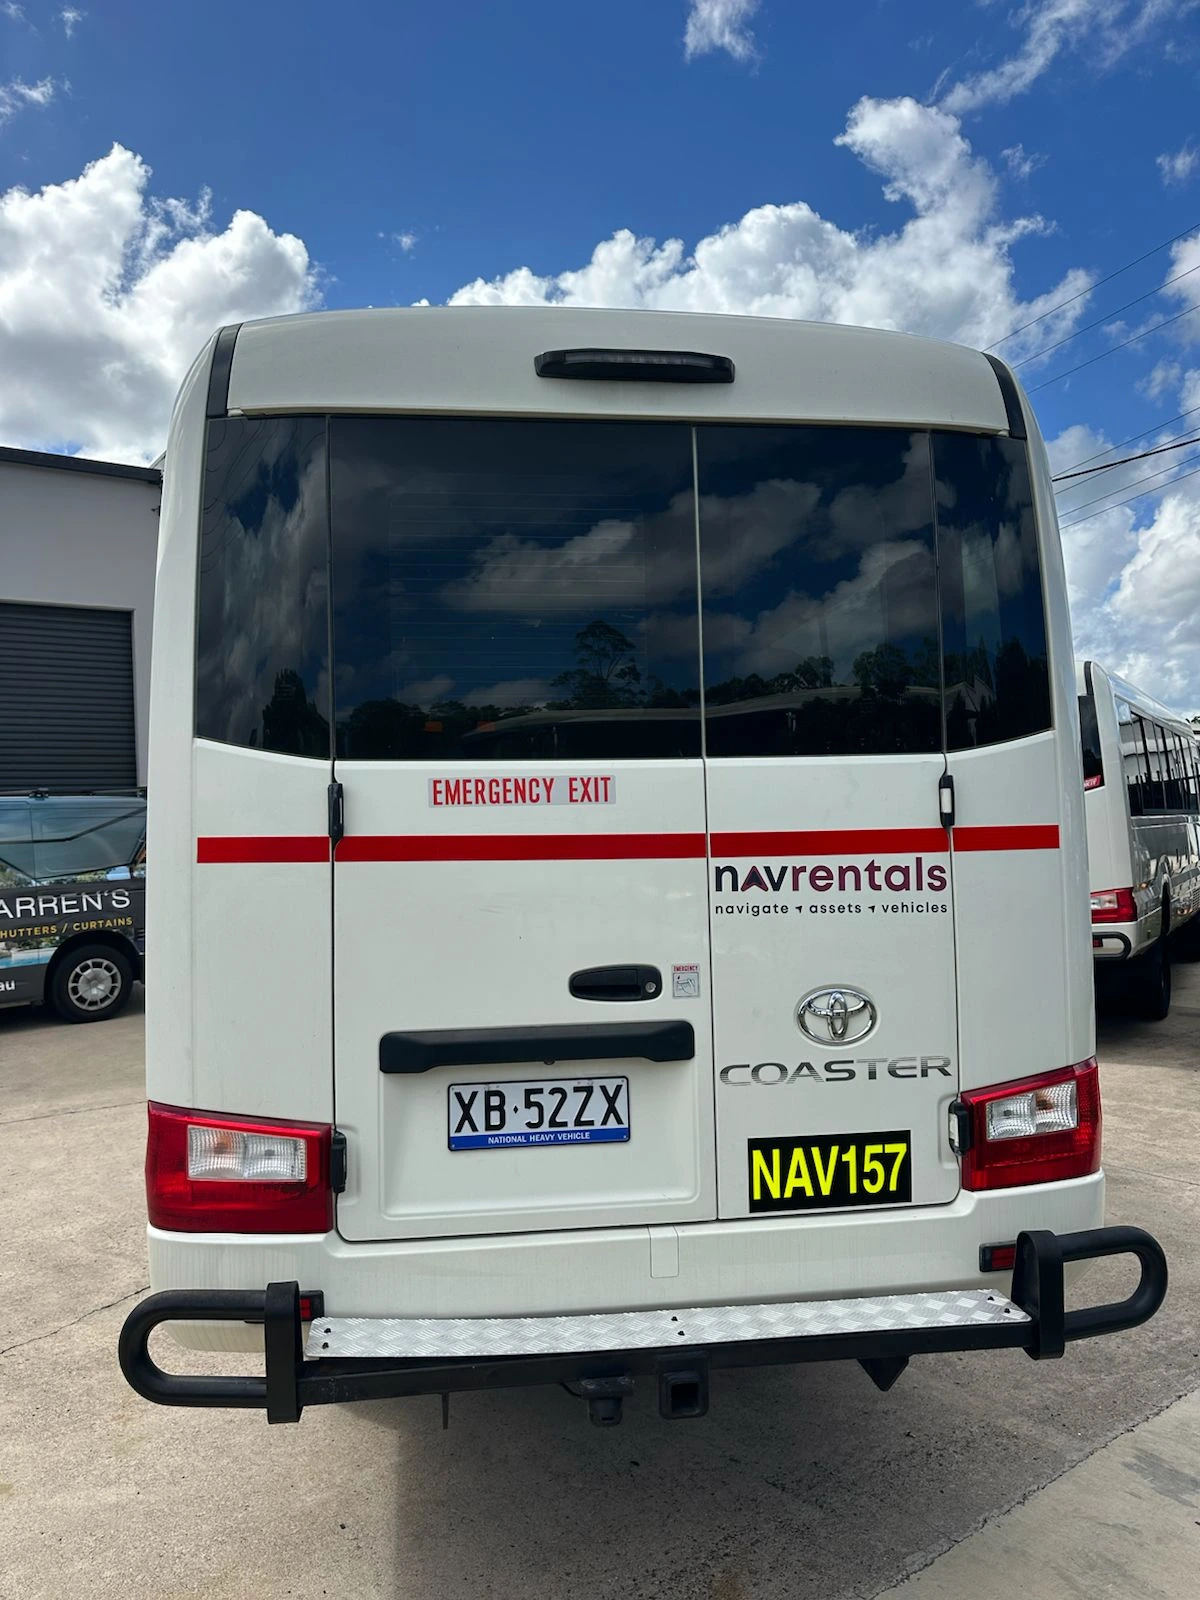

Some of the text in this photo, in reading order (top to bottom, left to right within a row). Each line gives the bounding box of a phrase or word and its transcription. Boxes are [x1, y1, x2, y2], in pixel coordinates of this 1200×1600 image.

[432, 776, 612, 806] EMERGENCY EXIT
[714, 856, 948, 893] navrentals
[714, 901, 949, 917] navigate assets vehicles
[0, 925, 57, 938] HUTTERS
[73, 917, 133, 931] CURTAINS
[719, 1055, 953, 1087] COASTER
[488, 1132, 590, 1144] NATIONAL HEAVY VEHICLE
[752, 1143, 907, 1200] NAV157
